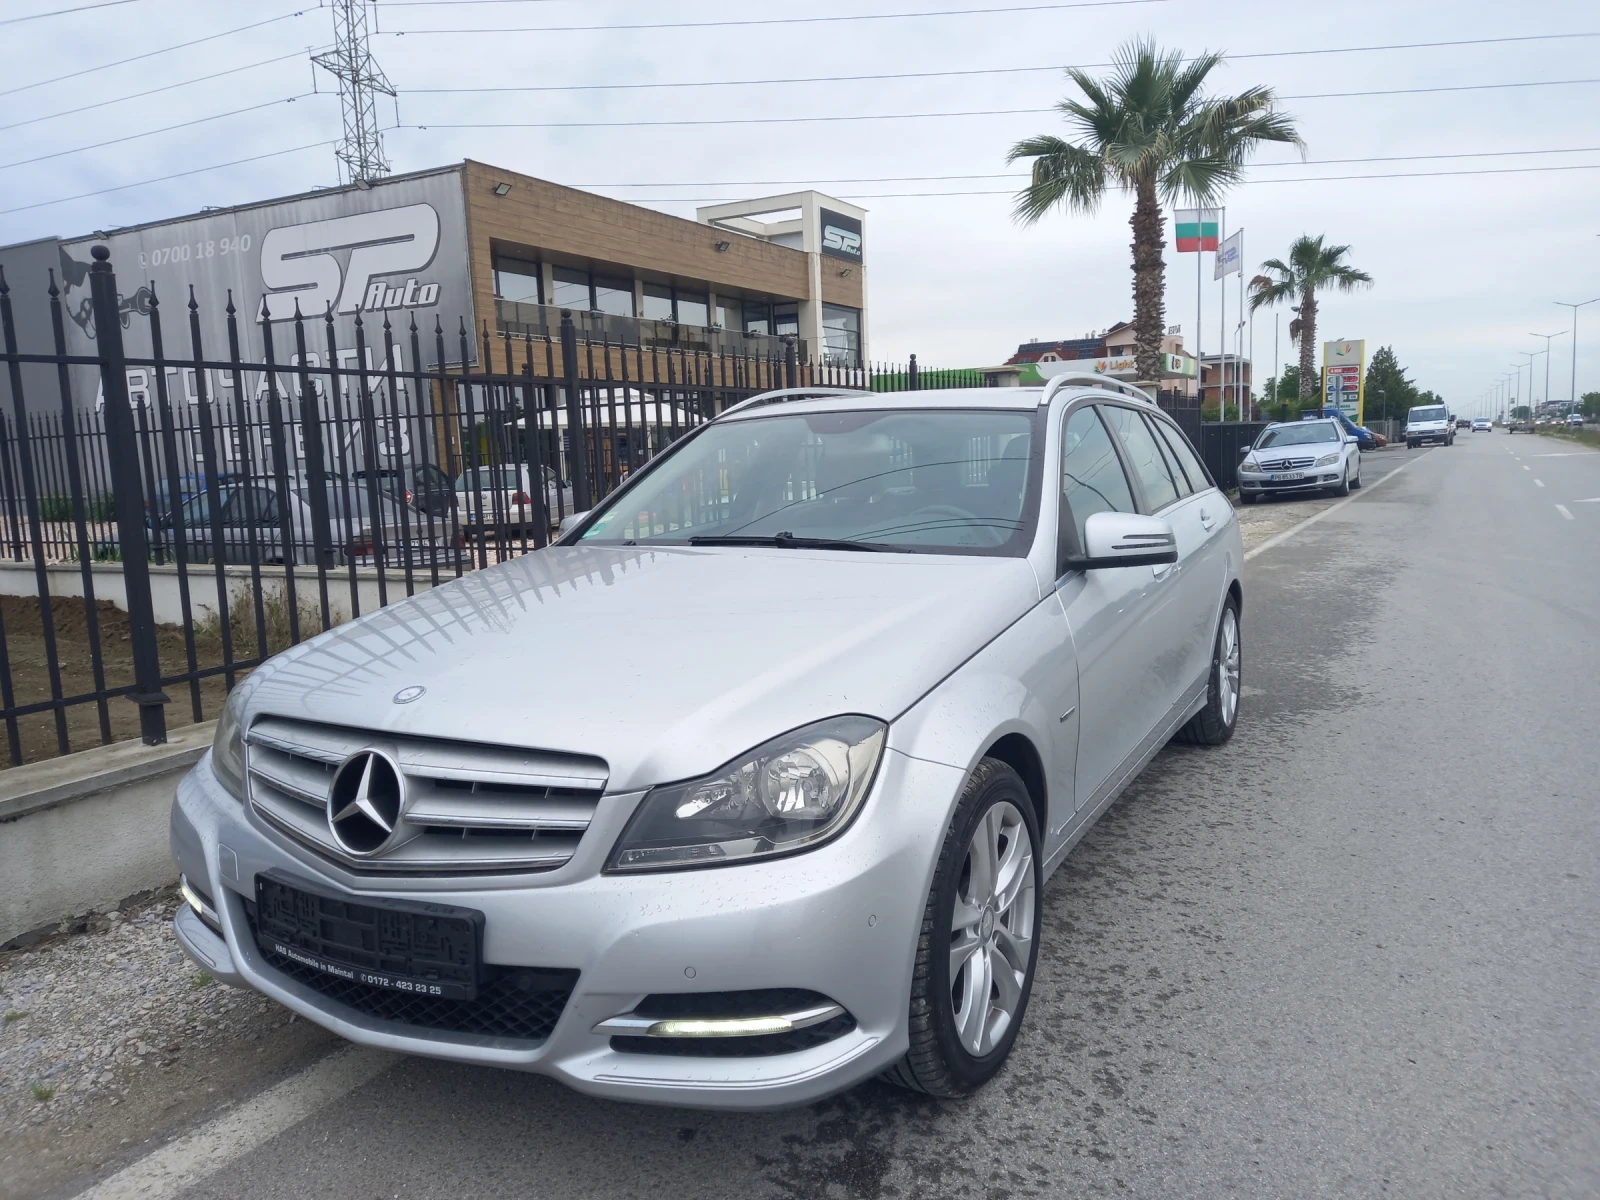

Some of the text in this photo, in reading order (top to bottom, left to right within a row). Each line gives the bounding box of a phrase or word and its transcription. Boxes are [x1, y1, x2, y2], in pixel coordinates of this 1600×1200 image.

[151, 234, 251, 266] 0700 18 940
[823, 224, 861, 251] SP
[255, 202, 441, 323] SP
[364, 278, 440, 312] Auto
[1110, 360, 1134, 371] Light
[275, 944, 287, 955] HAS
[288, 949, 319, 968] Automobile
[320, 961, 326, 971] in
[328, 964, 354, 979] Maintal
[367, 975, 389, 987] 0172
[396, 980, 413, 990] 423
[415, 983, 427, 993] 23
[429, 985, 442, 995] 25
